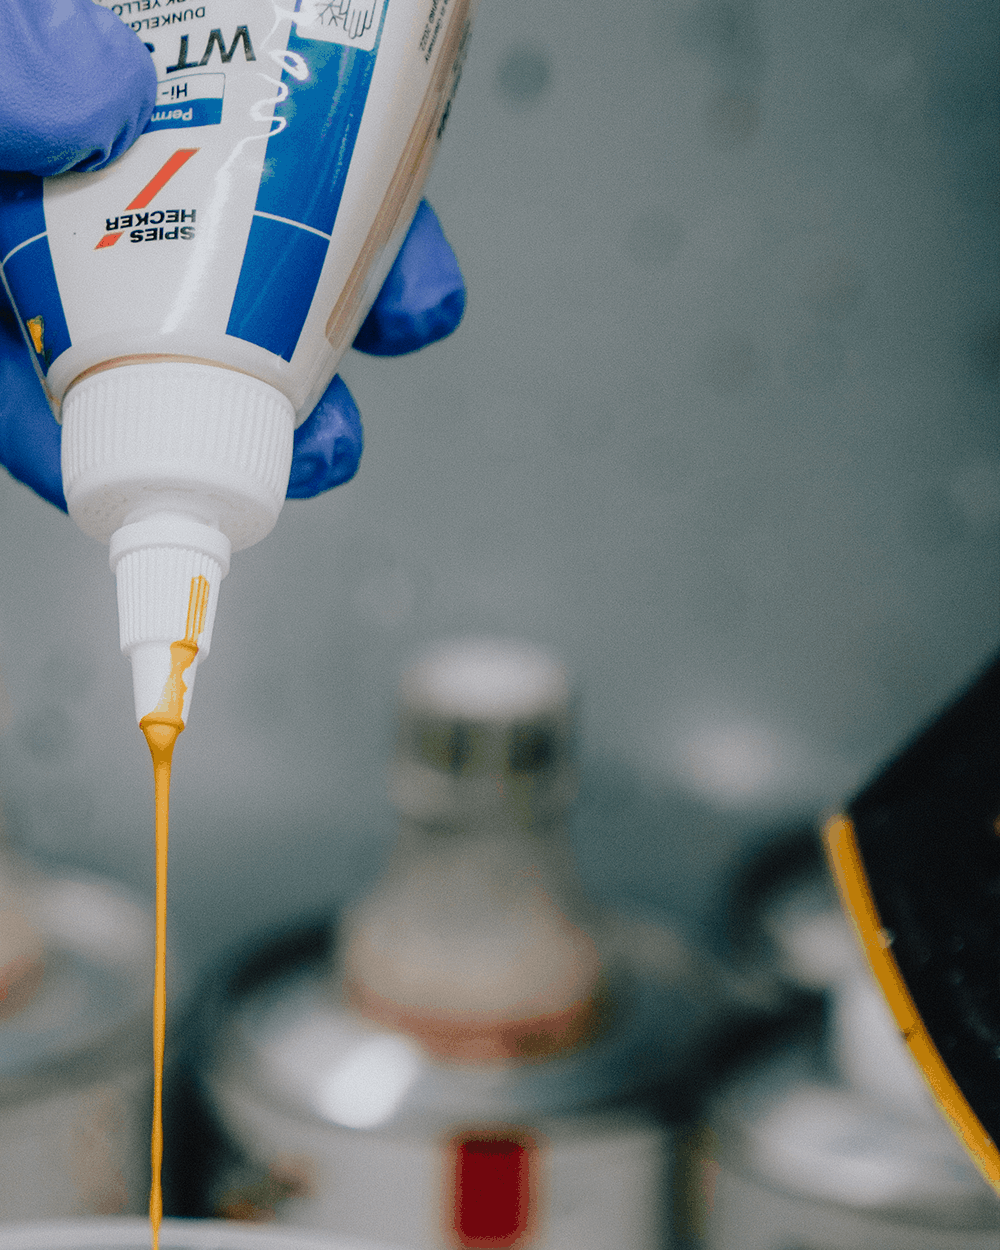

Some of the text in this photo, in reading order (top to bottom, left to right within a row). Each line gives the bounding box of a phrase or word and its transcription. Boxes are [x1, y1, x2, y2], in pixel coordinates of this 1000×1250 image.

[112, 0, 161, 16] YELLO
[127, 6, 205, 33] DUNKELG
[166, 25, 256, 74] WT
[162, 83, 188, 100] Hi-
[151, 107, 193, 121] Perm
[106, 209, 196, 231] HECKER
[130, 226, 196, 243] SPIES
